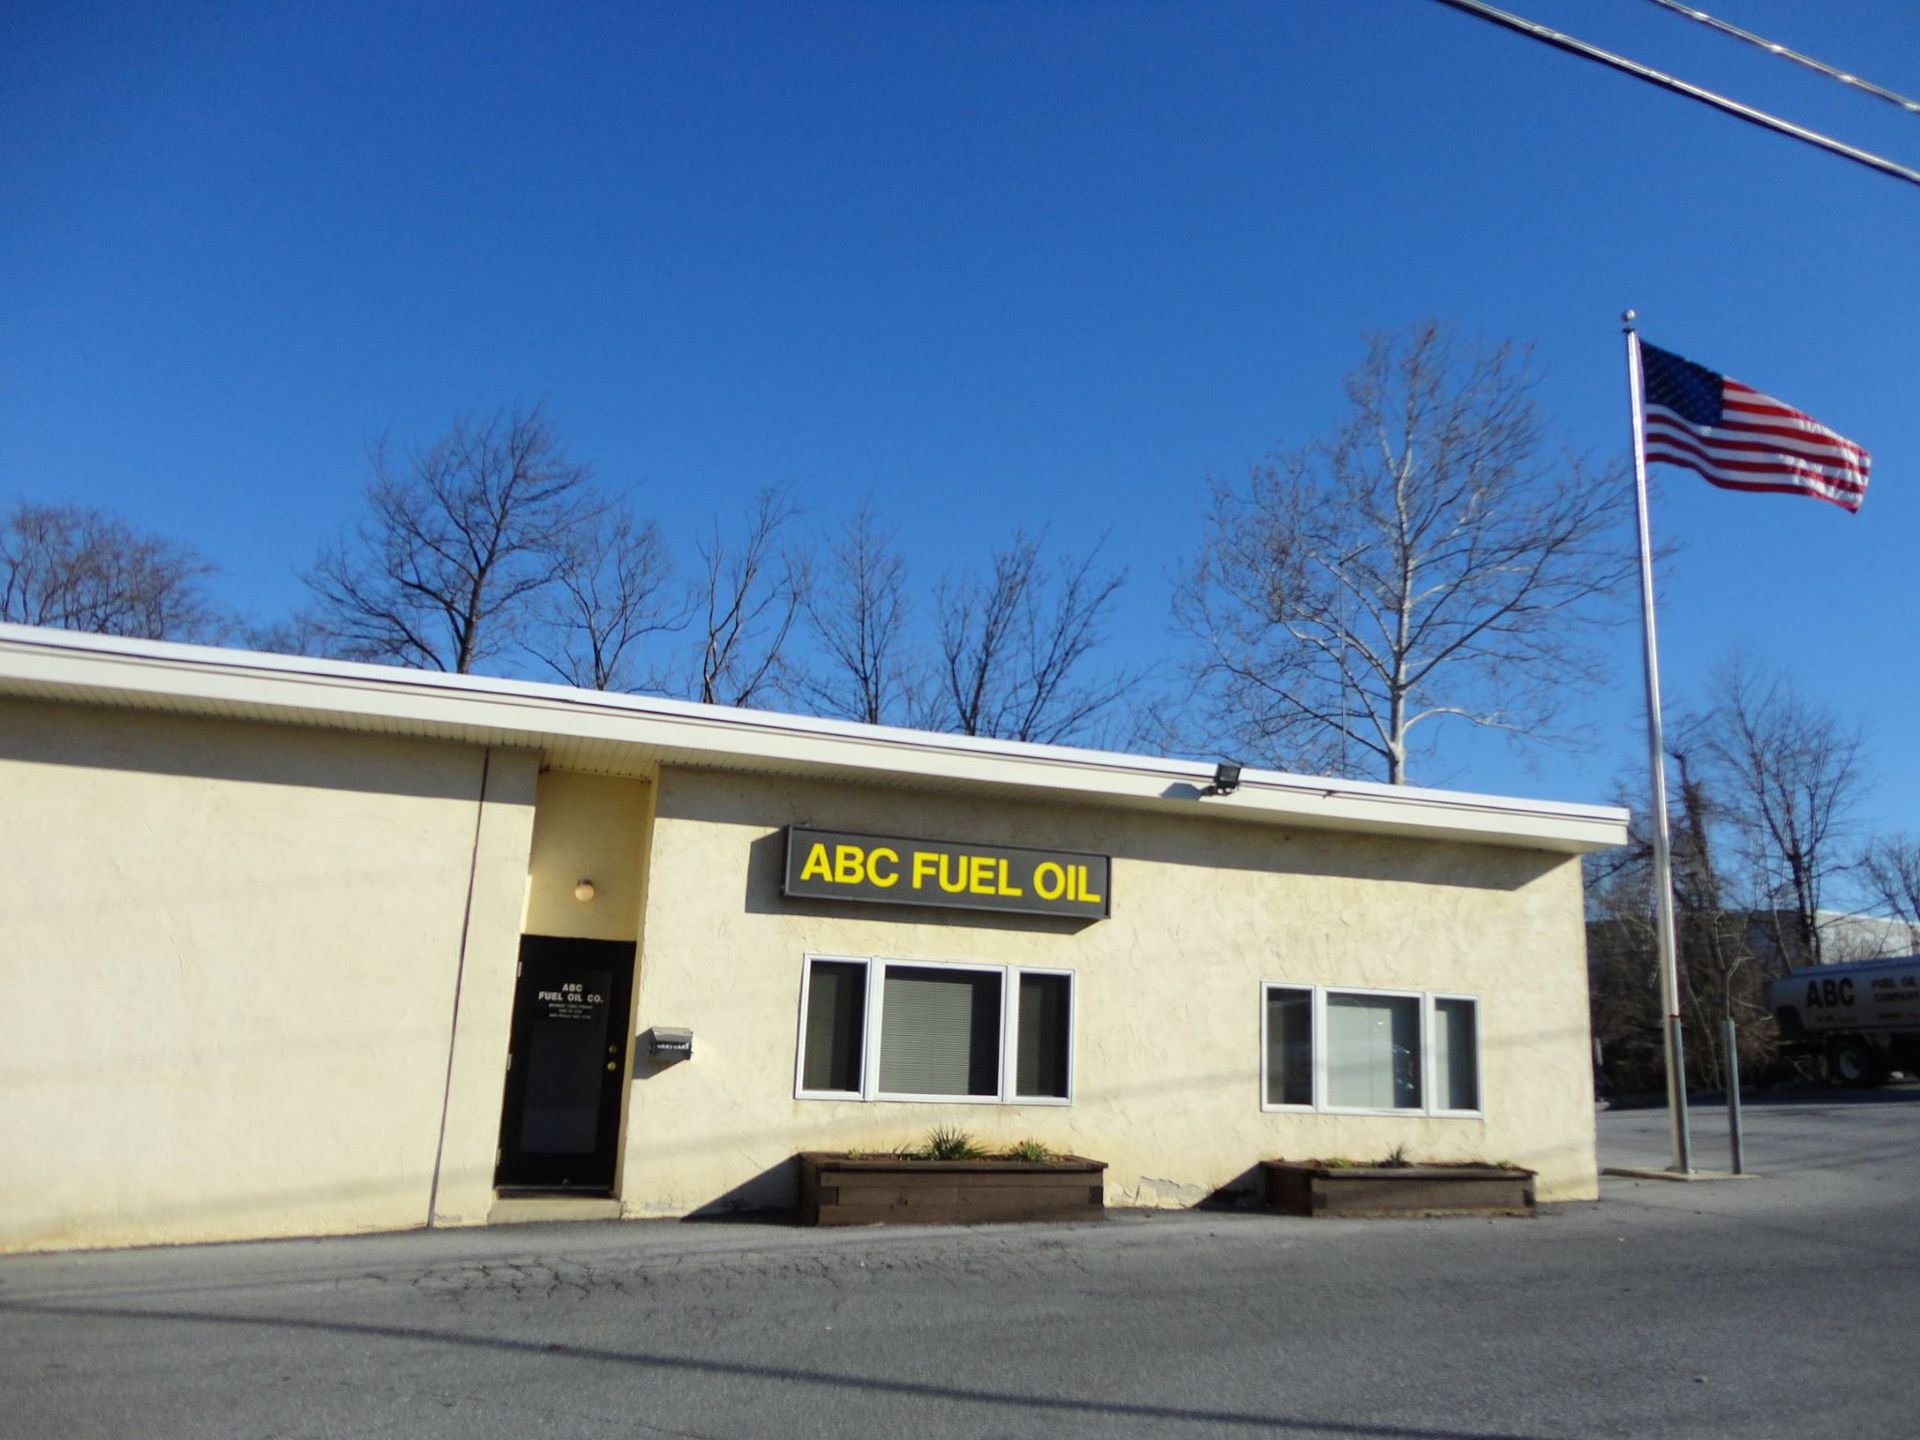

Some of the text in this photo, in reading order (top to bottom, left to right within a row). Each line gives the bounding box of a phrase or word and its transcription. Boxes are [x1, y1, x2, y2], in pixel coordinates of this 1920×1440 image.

[800, 843, 1102, 903] ABC FUEL OIL
[538, 991, 603, 1003] FUEL OIL CO.
[562, 983, 583, 992] ABC
[1806, 977, 1855, 1008] ABC
